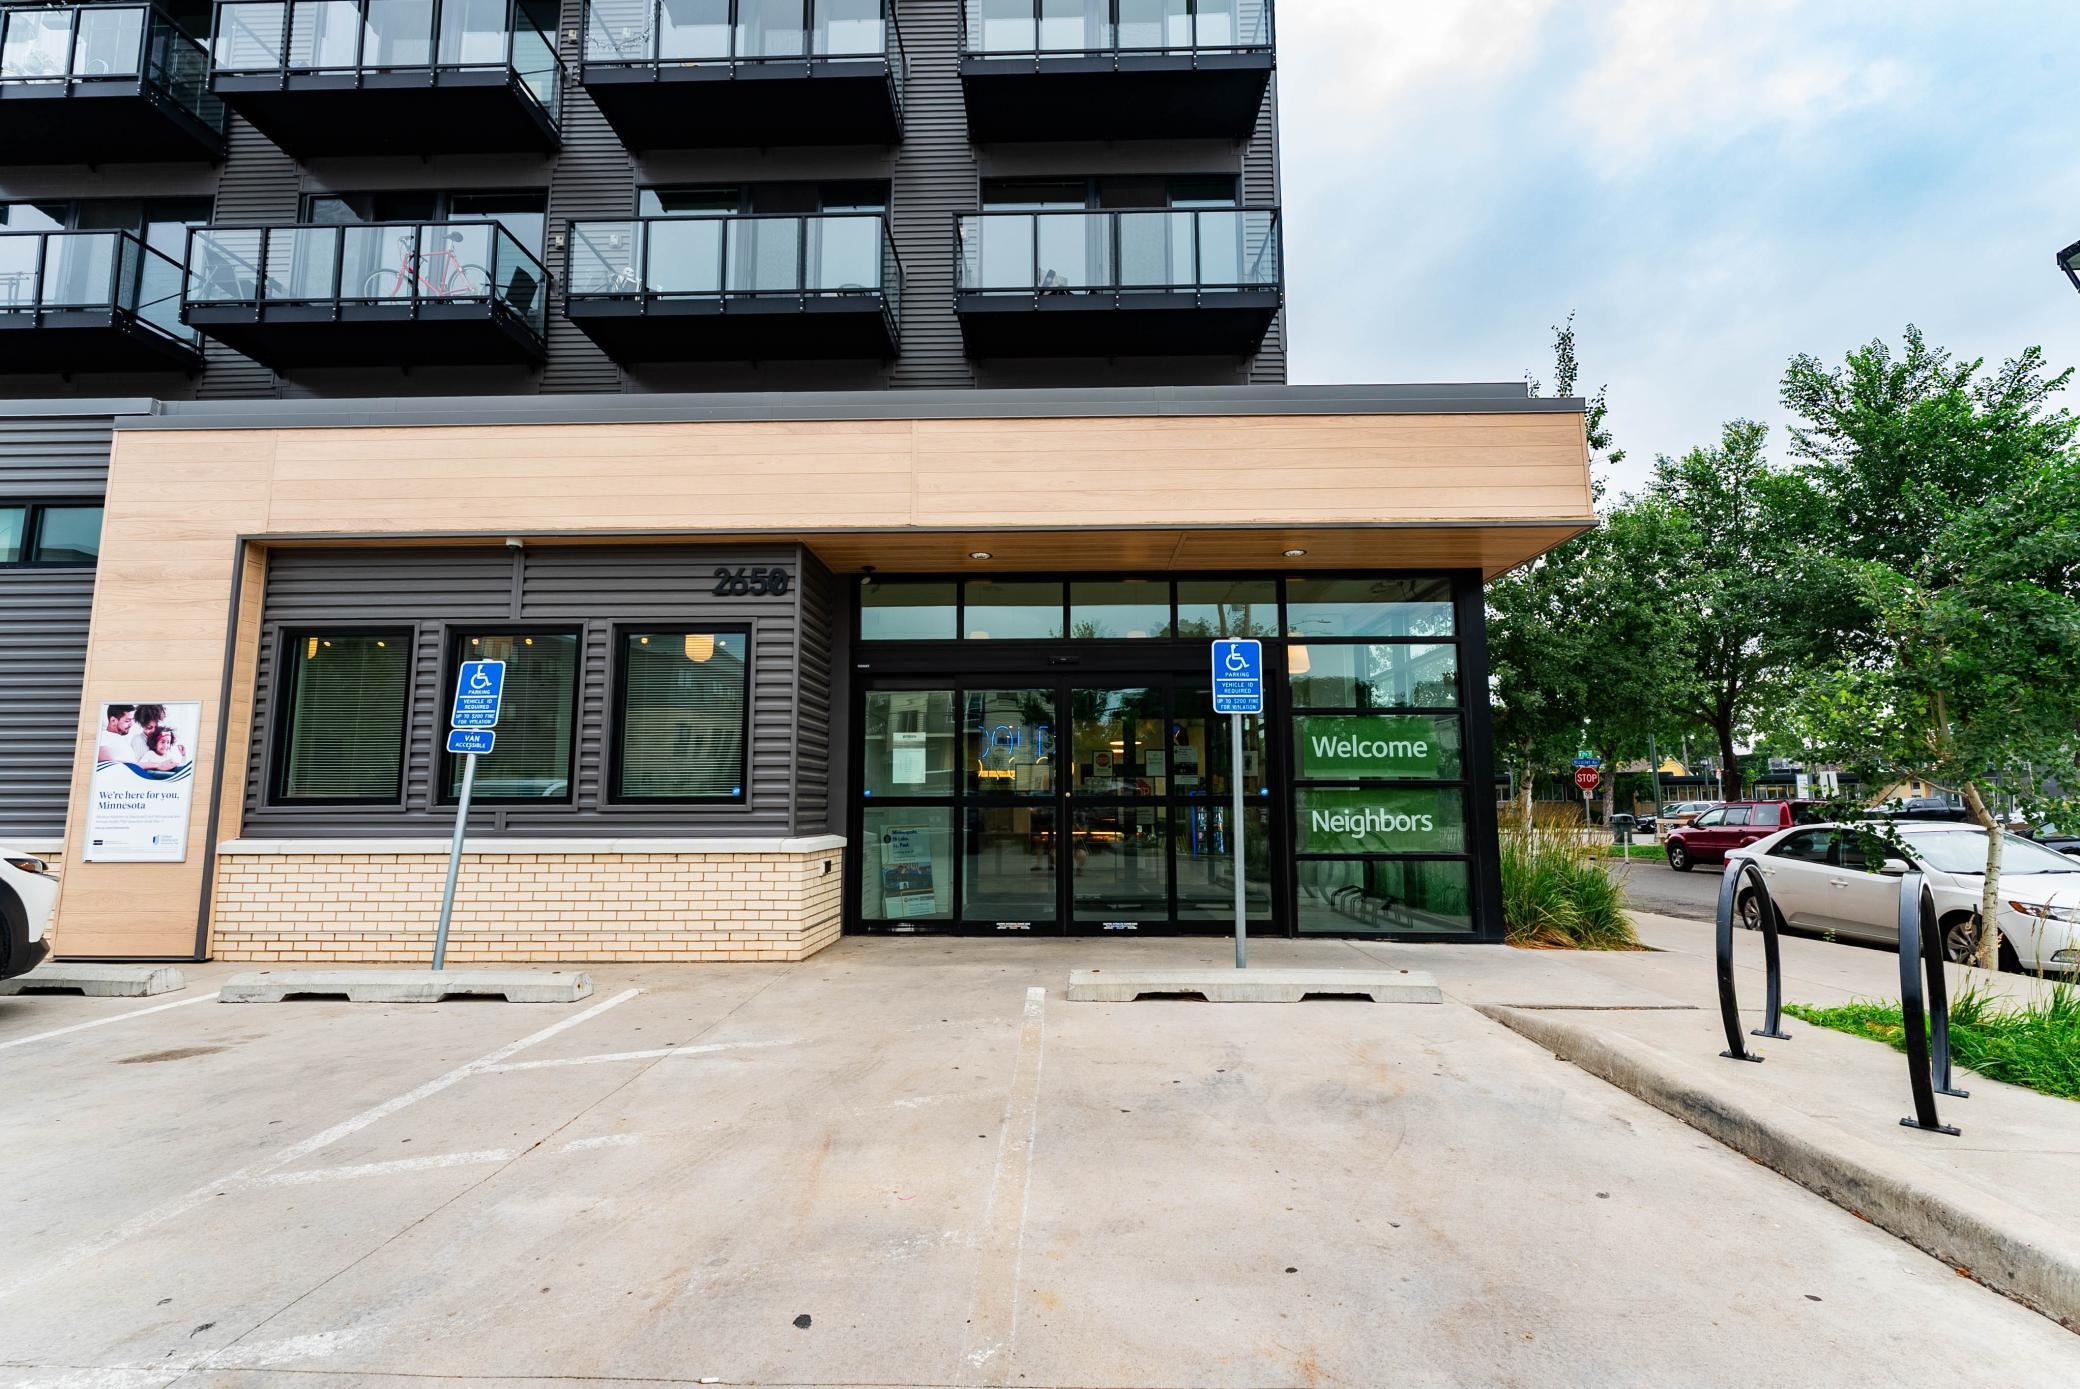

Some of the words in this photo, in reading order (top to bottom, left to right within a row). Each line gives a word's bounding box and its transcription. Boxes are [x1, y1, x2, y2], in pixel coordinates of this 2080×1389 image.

[712, 567, 789, 596] 2650
[1311, 734, 1428, 758] Welcome
[1577, 773, 1597, 783] STOP
[99, 791, 123, 799] We're
[125, 790, 144, 799] here
[146, 790, 160, 799] for
[98, 801, 146, 810] Minnesota
[1311, 807, 1433, 839] Neighbors
